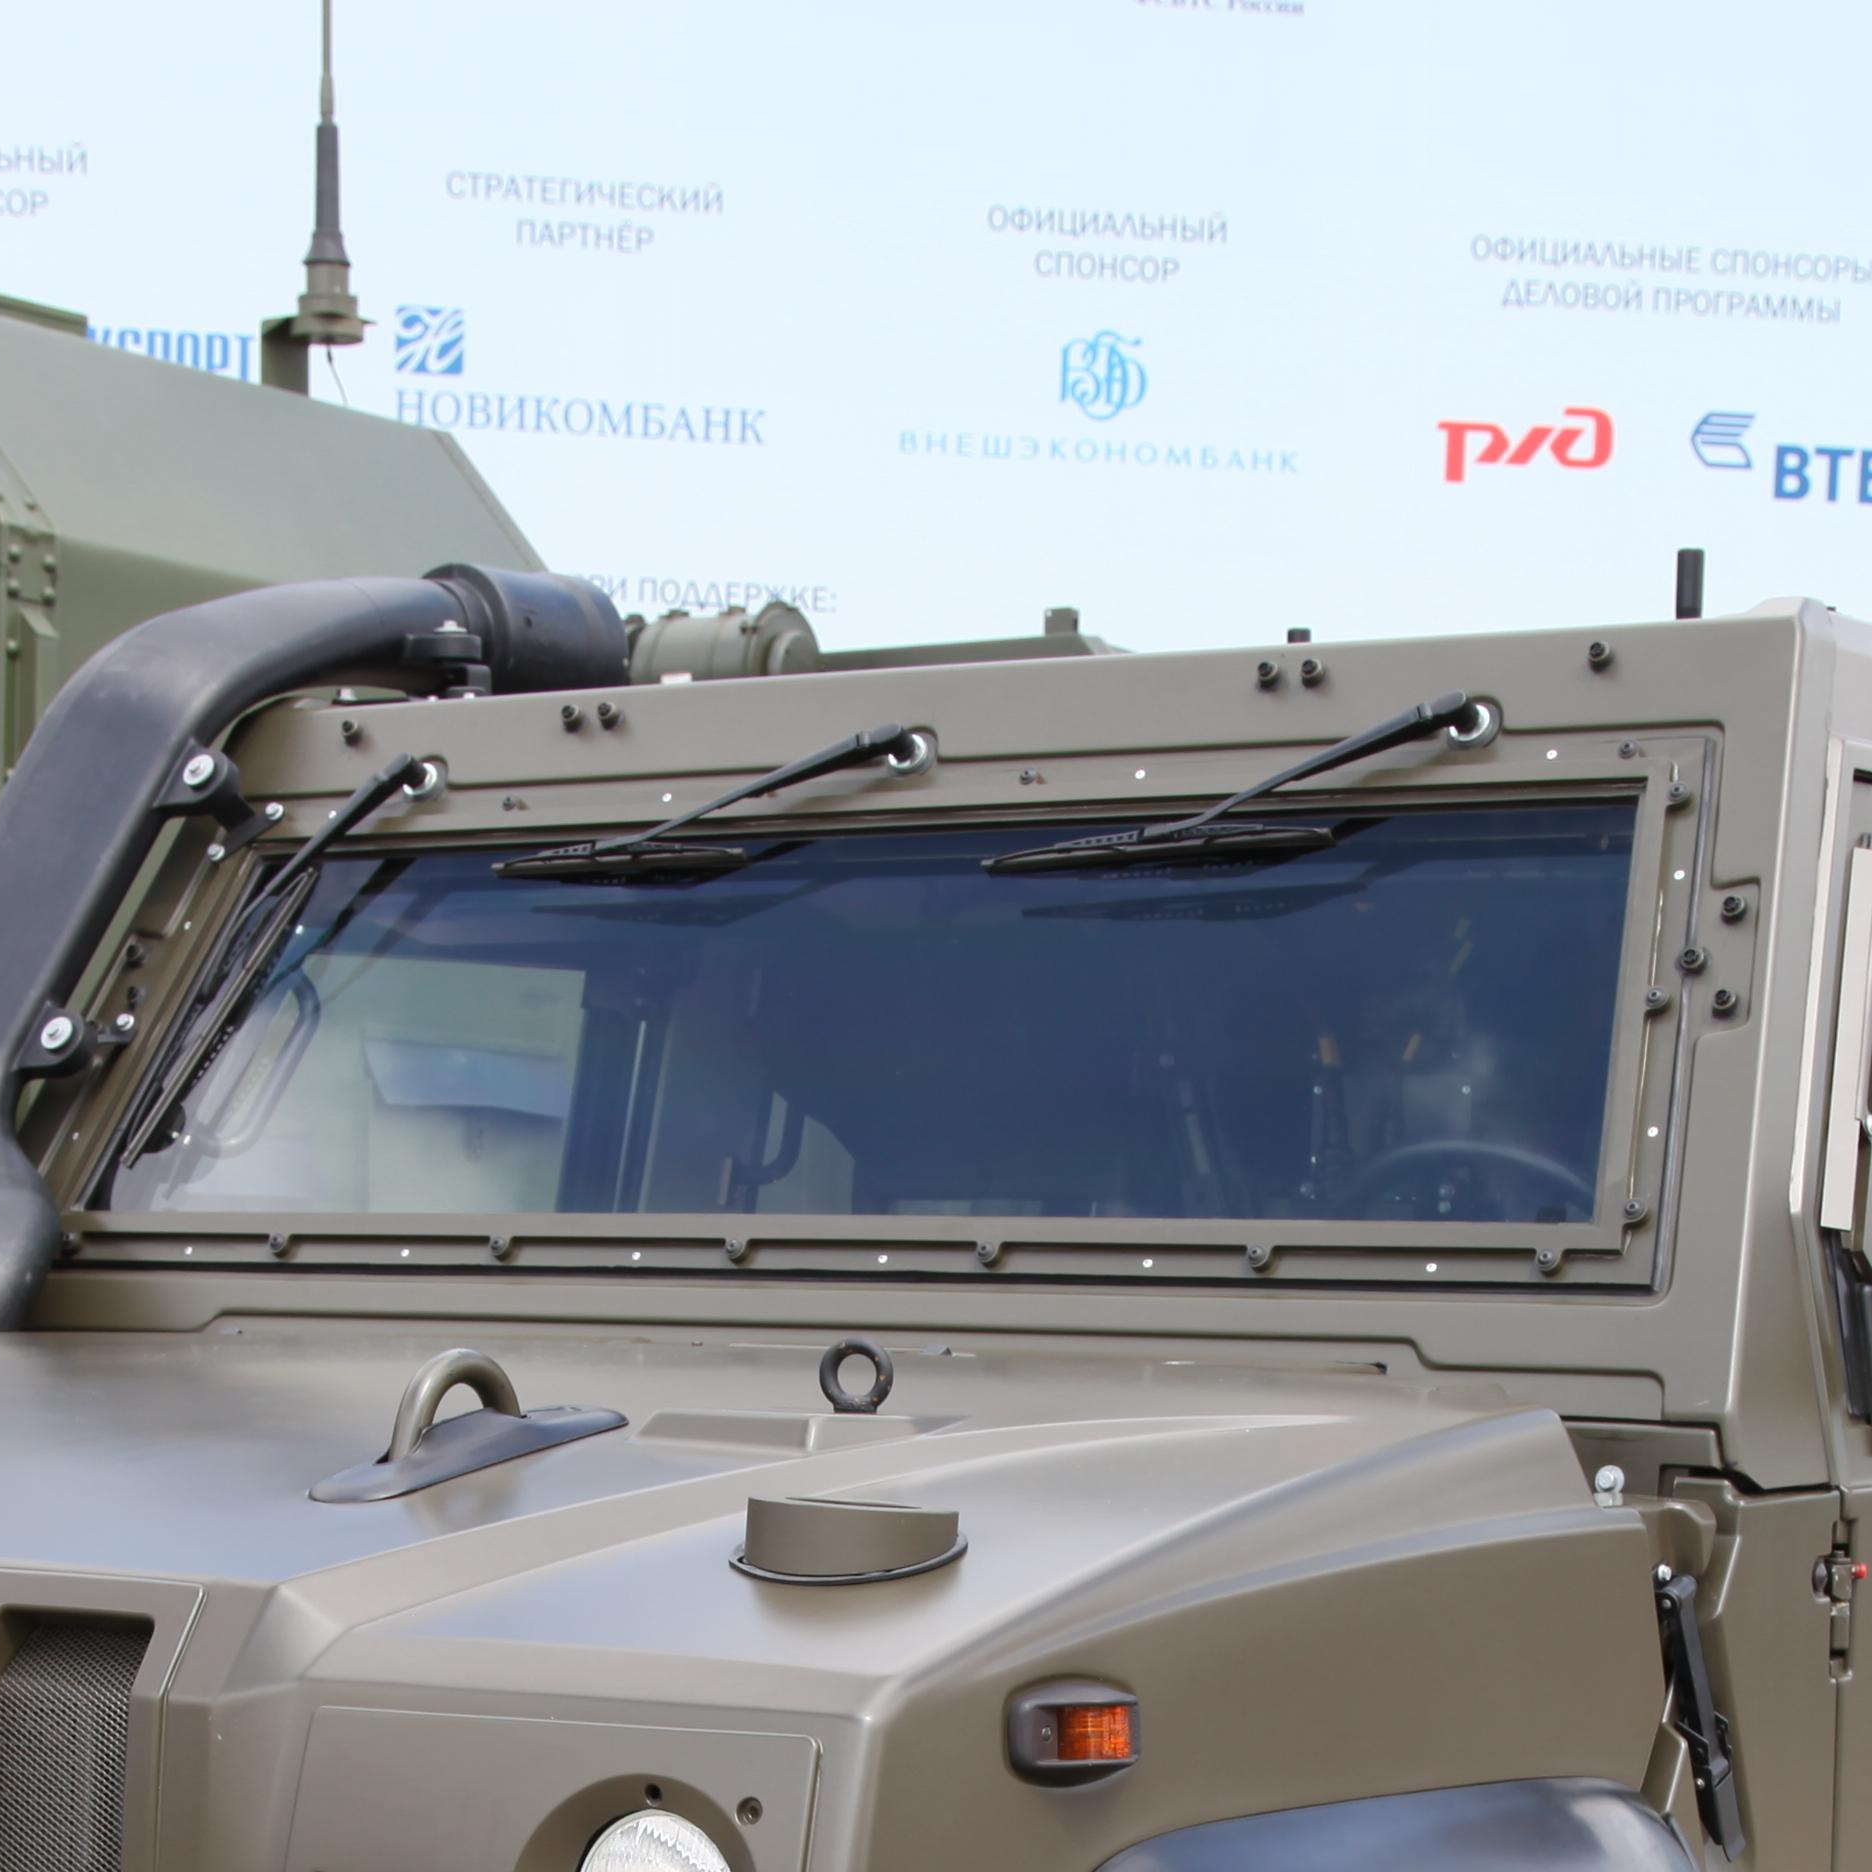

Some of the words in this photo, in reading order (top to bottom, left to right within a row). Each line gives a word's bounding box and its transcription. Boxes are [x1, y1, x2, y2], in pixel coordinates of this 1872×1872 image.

[445, 169, 724, 214] СТРАТЕГИЧЕСКИЙ
[515, 218, 654, 253] ПАРТНЁР
[986, 203, 1228, 244] ОФИЦИАЛЬНЫЙ
[1033, 249, 1181, 284] СПОНСОР
[1469, 234, 1701, 275] ОФИЦИАЛЬНЫЕ
[1501, 278, 1643, 313] ДЕЛОВОЙ
[1652, 286, 1842, 324] ПРОГРАММЫ
[394, 388, 766, 445] НОВИКОМБАНК
[897, 430, 1300, 475] ВНЕШЭКОНОМБАНК
[638, 577, 838, 614] ПОДДЕРЖКЕ:
